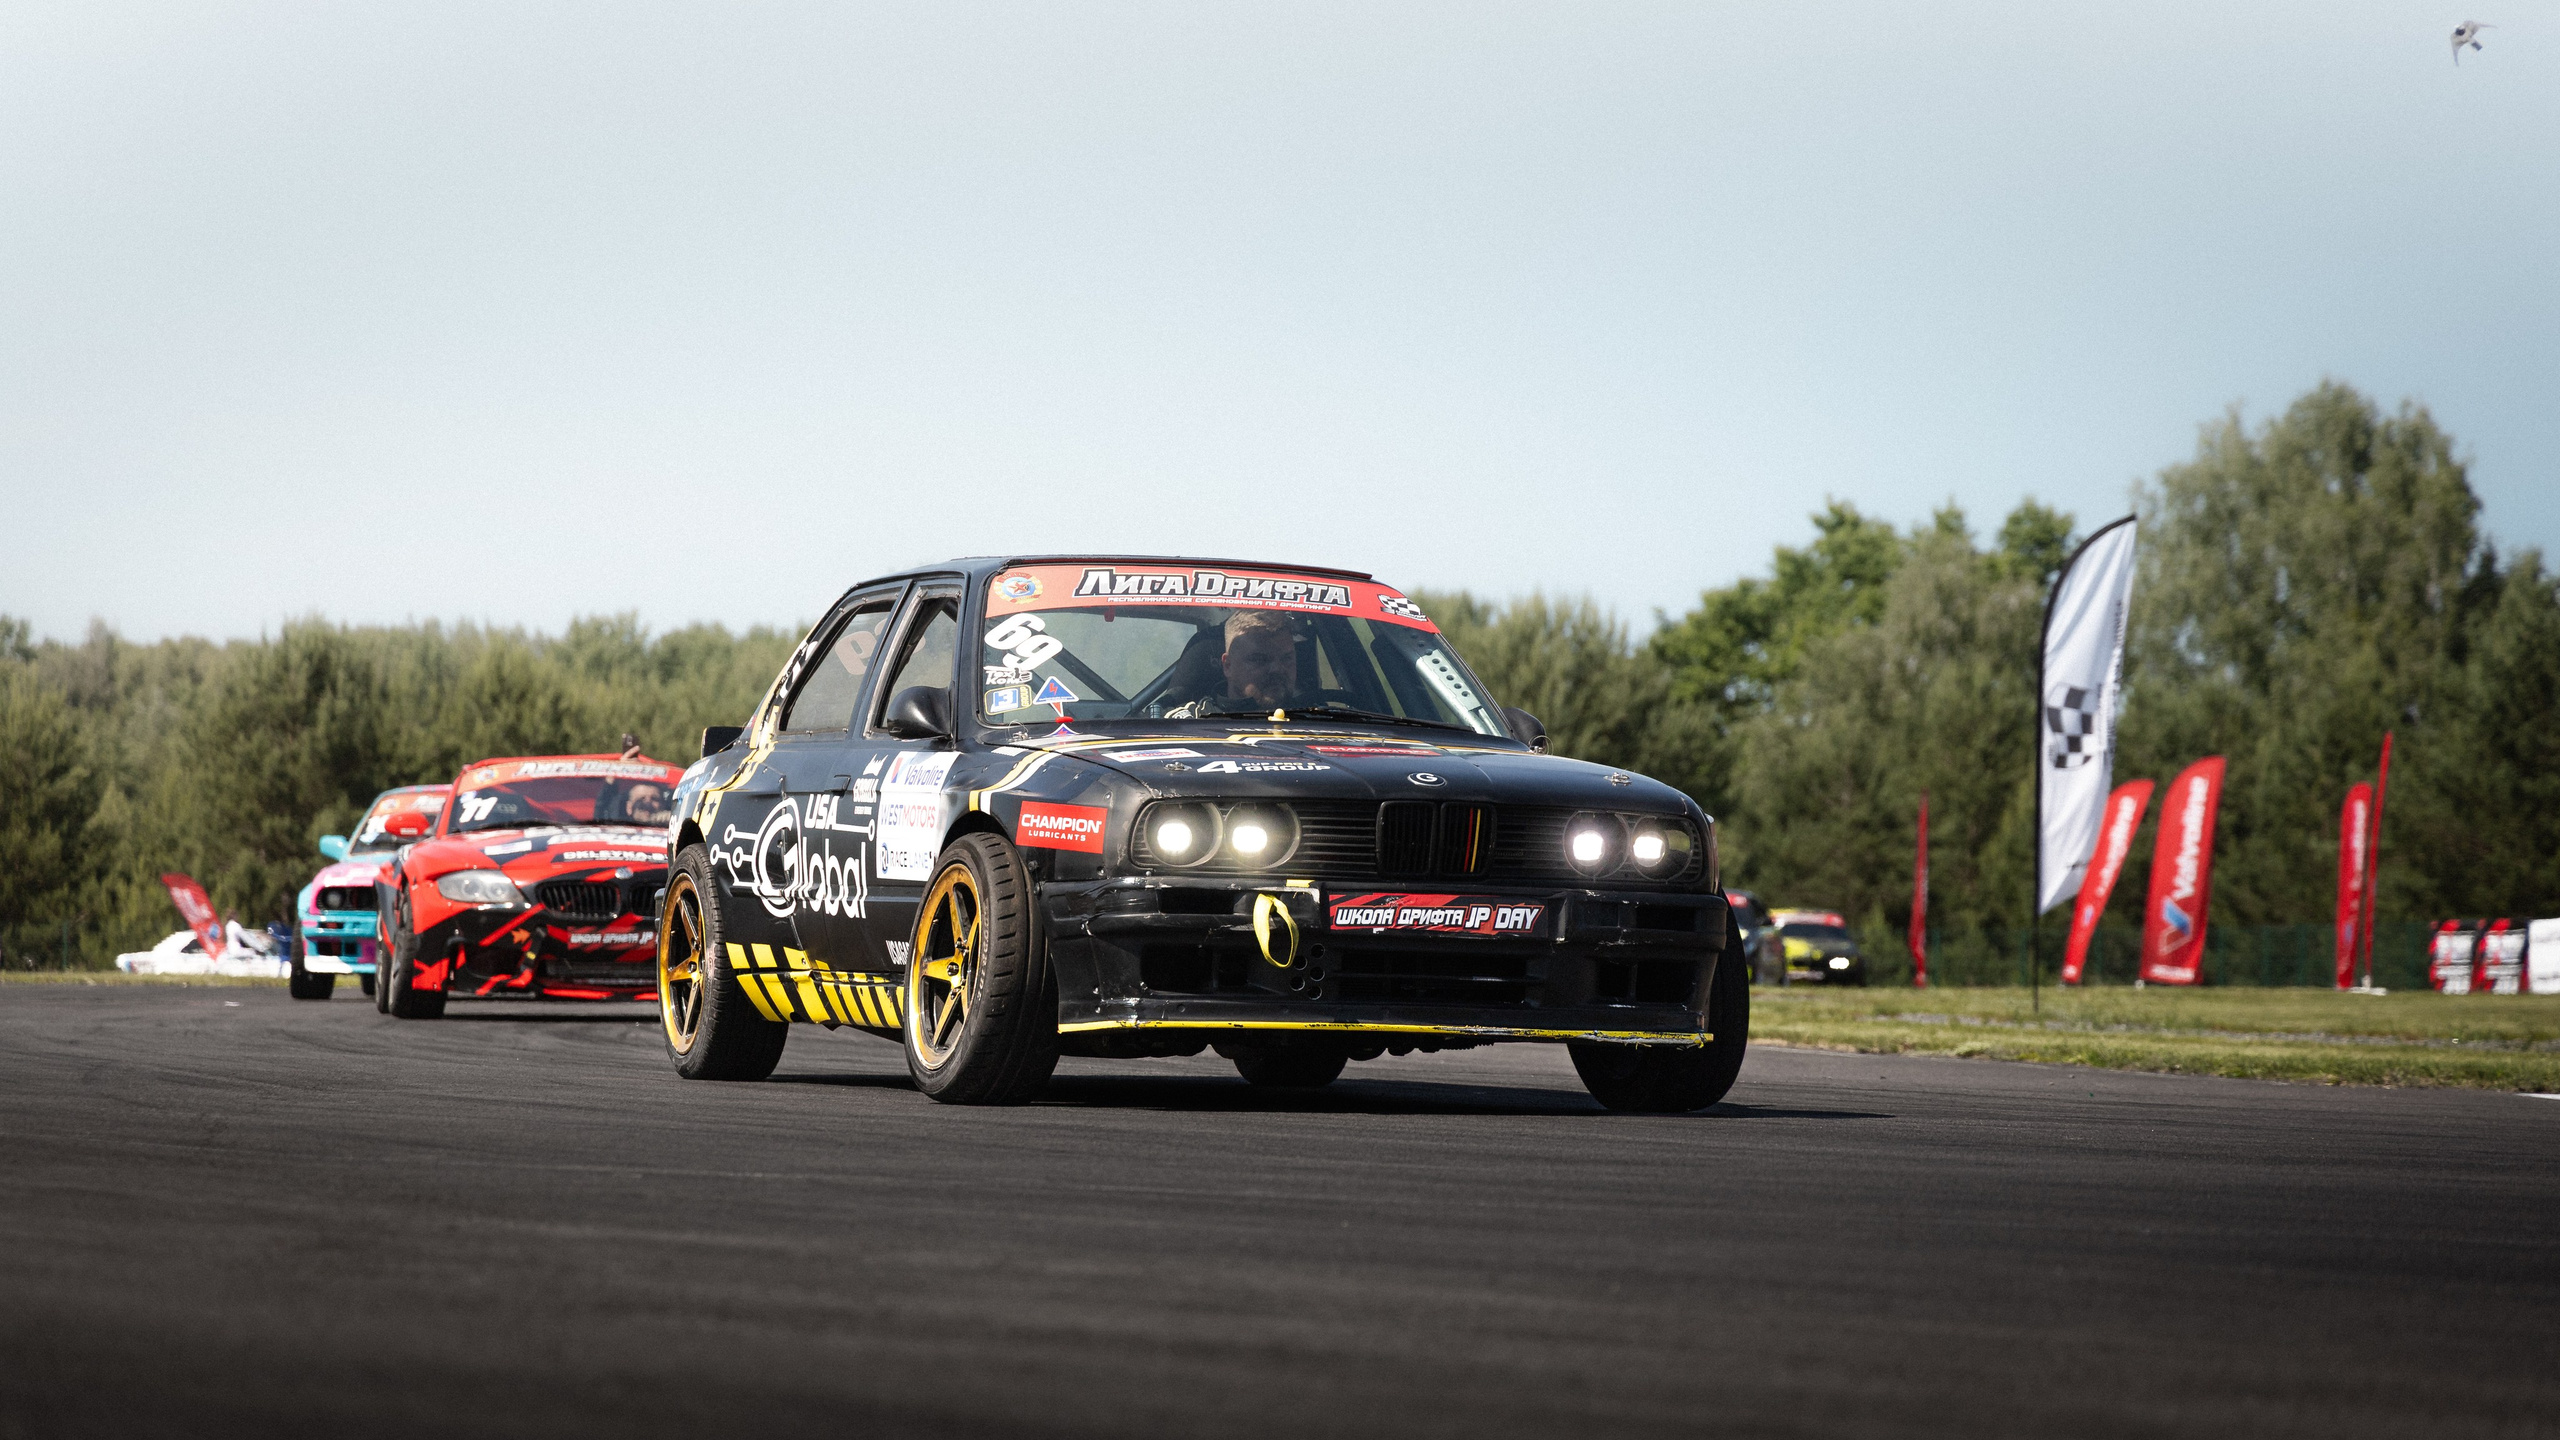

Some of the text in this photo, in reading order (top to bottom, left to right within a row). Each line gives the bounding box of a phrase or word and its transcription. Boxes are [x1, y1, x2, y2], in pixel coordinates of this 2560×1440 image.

[984, 613, 1063, 671] 69
[1197, 760, 1242, 774] 4
[1244, 764, 1331, 772] GROUP
[804, 793, 841, 830] USA
[1020, 813, 1102, 834] CHAMPION
[1028, 829, 1087, 842] LUBRICANTS
[751, 797, 868, 919] Global
[1335, 903, 1540, 930] ШКОЛА ДРИФТА JP DAY
